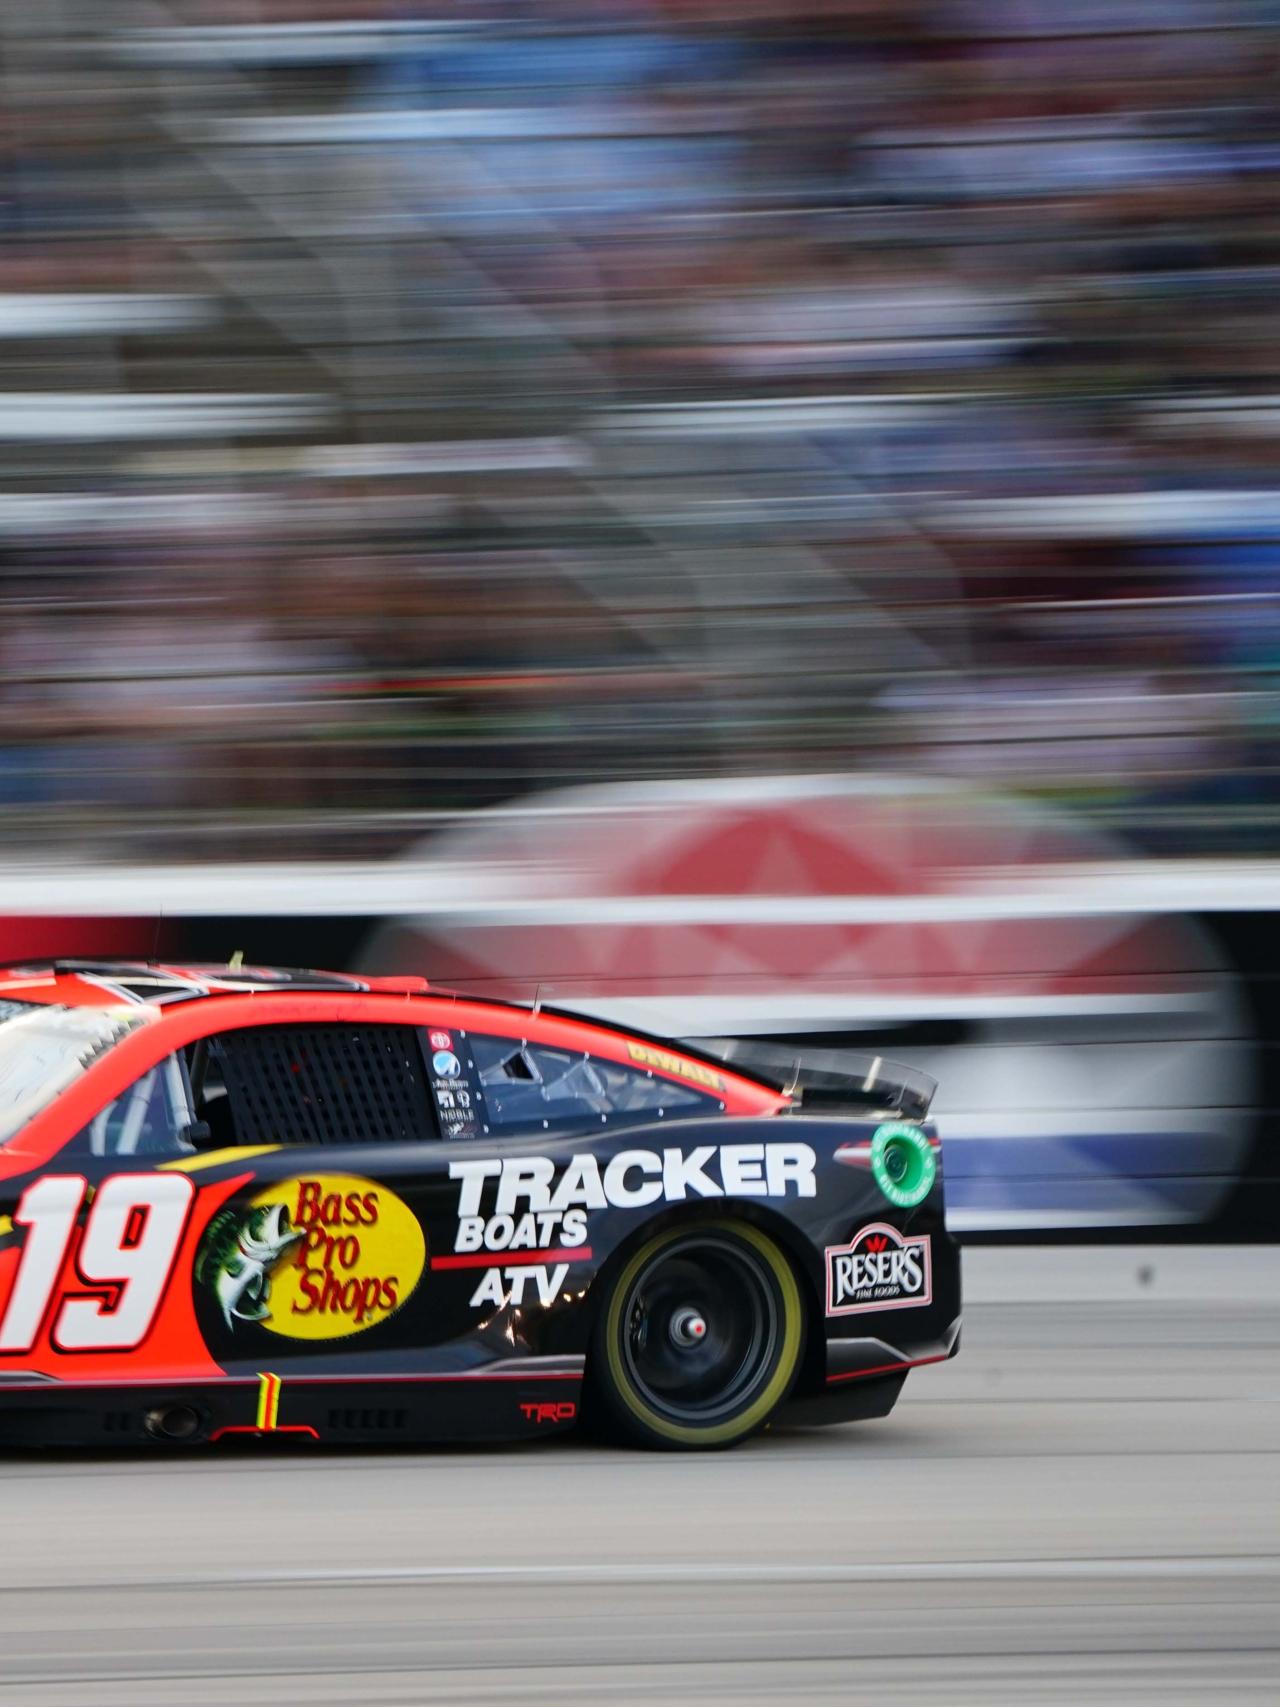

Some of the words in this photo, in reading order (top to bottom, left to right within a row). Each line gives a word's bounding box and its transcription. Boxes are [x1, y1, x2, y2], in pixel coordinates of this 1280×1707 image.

[293, 1179, 379, 1227] Bass
[448, 1142, 817, 1218] TRACKER
[292, 1223, 361, 1270] Pro
[454, 1209, 588, 1253] BOATS
[291, 1267, 399, 1324] Shops
[469, 1263, 570, 1308] ATV
[835, 1246, 923, 1305] RESER'S
[519, 1402, 576, 1423] TRD
